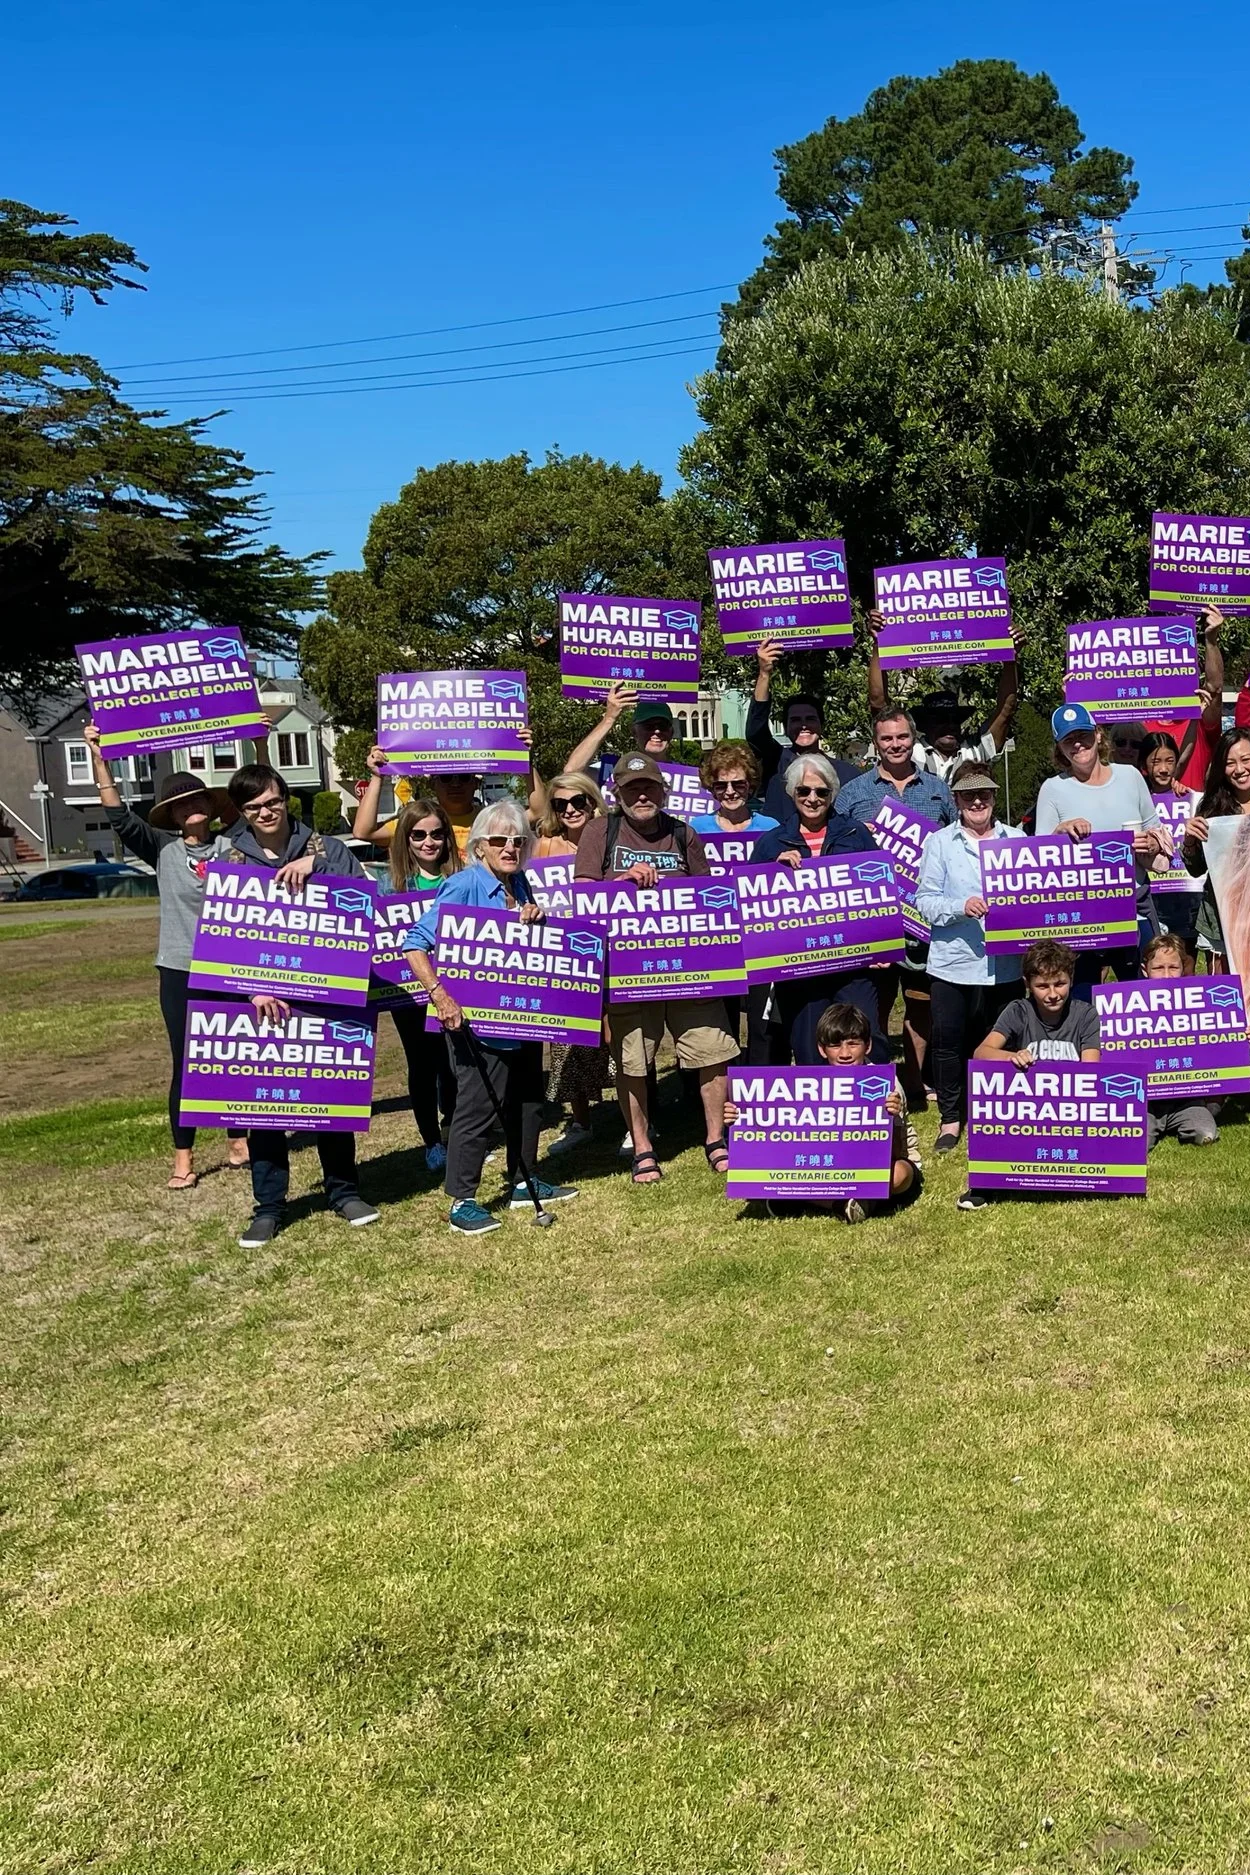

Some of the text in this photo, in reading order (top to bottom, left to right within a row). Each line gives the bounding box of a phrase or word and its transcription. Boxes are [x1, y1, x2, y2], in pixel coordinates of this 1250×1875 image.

[1155, 522, 1244, 544] MARIE
[712, 552, 806, 579] MARIE
[1154, 563, 1176, 571] FOR
[1180, 565, 1233, 574] COLLEGE
[716, 570, 845, 599] HURABIELL
[877, 568, 972, 595] MARIE
[877, 590, 1006, 613] HURABIELL
[1179, 594, 1247, 604] VOTEMARIE.COM
[563, 603, 660, 628] MARIE
[563, 626, 696, 649] HURABIELL
[912, 642, 985, 652] VOTEMARIE.COM
[1070, 626, 1160, 652] MARIE
[82, 640, 204, 676] MARIE
[564, 645, 696, 661] FOR COLLEGE BOARD
[1069, 648, 1195, 670] HURABIELL
[88, 662, 249, 697] HURABIELL
[380, 679, 484, 700] MARIE
[94, 679, 253, 710] FOR COLLEGE BOARD
[1099, 700, 1171, 709] VOTEMARIE.COM
[380, 701, 523, 719] HURABIELL
[138, 719, 230, 738] VOTEMARIE.COM
[622, 851, 651, 862] TOUR
[983, 843, 1093, 870] MARIE
[738, 864, 852, 898] MARIE
[985, 867, 1132, 892] HURABIELL
[576, 888, 696, 915] MARIE
[741, 886, 896, 920] HURABIELL
[202, 901, 370, 937] HURABIELL
[594, 912, 740, 941] URABIELL
[744, 922, 775, 934] FOR
[778, 913, 846, 930] COLLEGE
[848, 906, 898, 920] BOARD
[200, 924, 232, 936] FOR
[235, 928, 310, 945] COLLEGE
[314, 936, 369, 952] BOARD
[441, 915, 564, 950] MARIE
[1022, 925, 1105, 938] VOTEMARIE.COM
[438, 943, 600, 979] HURABIELL
[783, 945, 870, 964] VOTEMARIE.COM
[231, 968, 328, 984] VOTEMARIE.COM
[436, 966, 471, 980] FOR
[474, 971, 548, 987] COLLEGE
[551, 979, 600, 993] BOARD
[618, 973, 710, 985] VOTEMARIE.COM
[1096, 987, 1205, 1015] MARIE
[471, 1010, 566, 1025] VOTEMARIE.COM
[1096, 1008, 1242, 1037] HURABIELL
[189, 1040, 370, 1066] HURABIELL
[188, 1063, 370, 1080] FOR COLLEGE BOARD
[1147, 1071, 1218, 1084] TEMARIE.COM
[732, 1078, 854, 1102] MARIE
[973, 1072, 1097, 1097] MARIE
[226, 1104, 329, 1114] VOTEMARIE.COM
[735, 1104, 892, 1126] HURABIELL
[973, 1101, 1142, 1122] HURABIELL
[734, 1130, 892, 1142] FOR COLLEGE BOARD
[973, 1124, 1143, 1137] FOR COLLEGE BOARD
[769, 1172, 856, 1180] VOTEMARIE.COM
[1010, 1164, 1106, 1174] VOTEMARIE.COM
